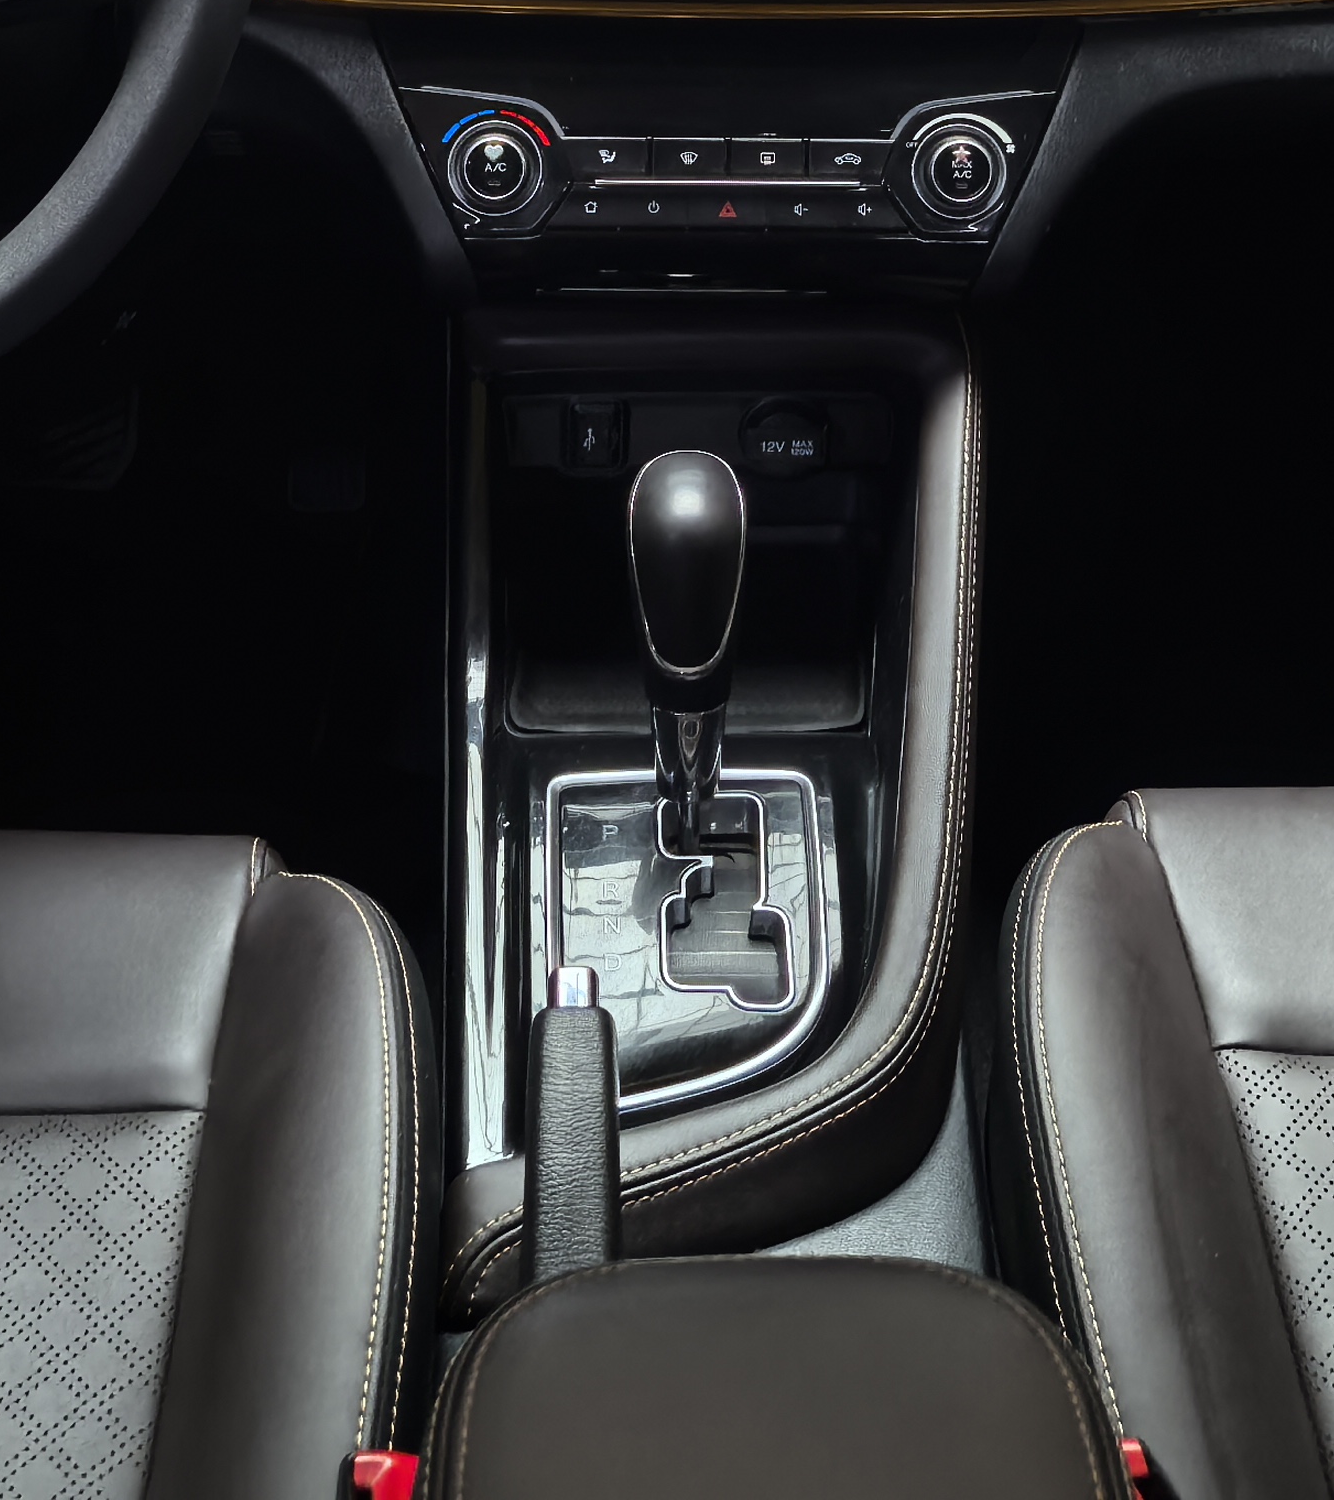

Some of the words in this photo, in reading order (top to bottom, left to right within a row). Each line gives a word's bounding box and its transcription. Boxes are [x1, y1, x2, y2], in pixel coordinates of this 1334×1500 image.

[484, 162, 508, 173] A/C
[953, 170, 972, 180] A/C
[761, 440, 786, 453] 12V
[792, 440, 814, 448] MAX
[602, 824, 619, 841] P
[601, 880, 620, 898] R
[603, 916, 622, 934] N
[603, 953, 623, 972] D
